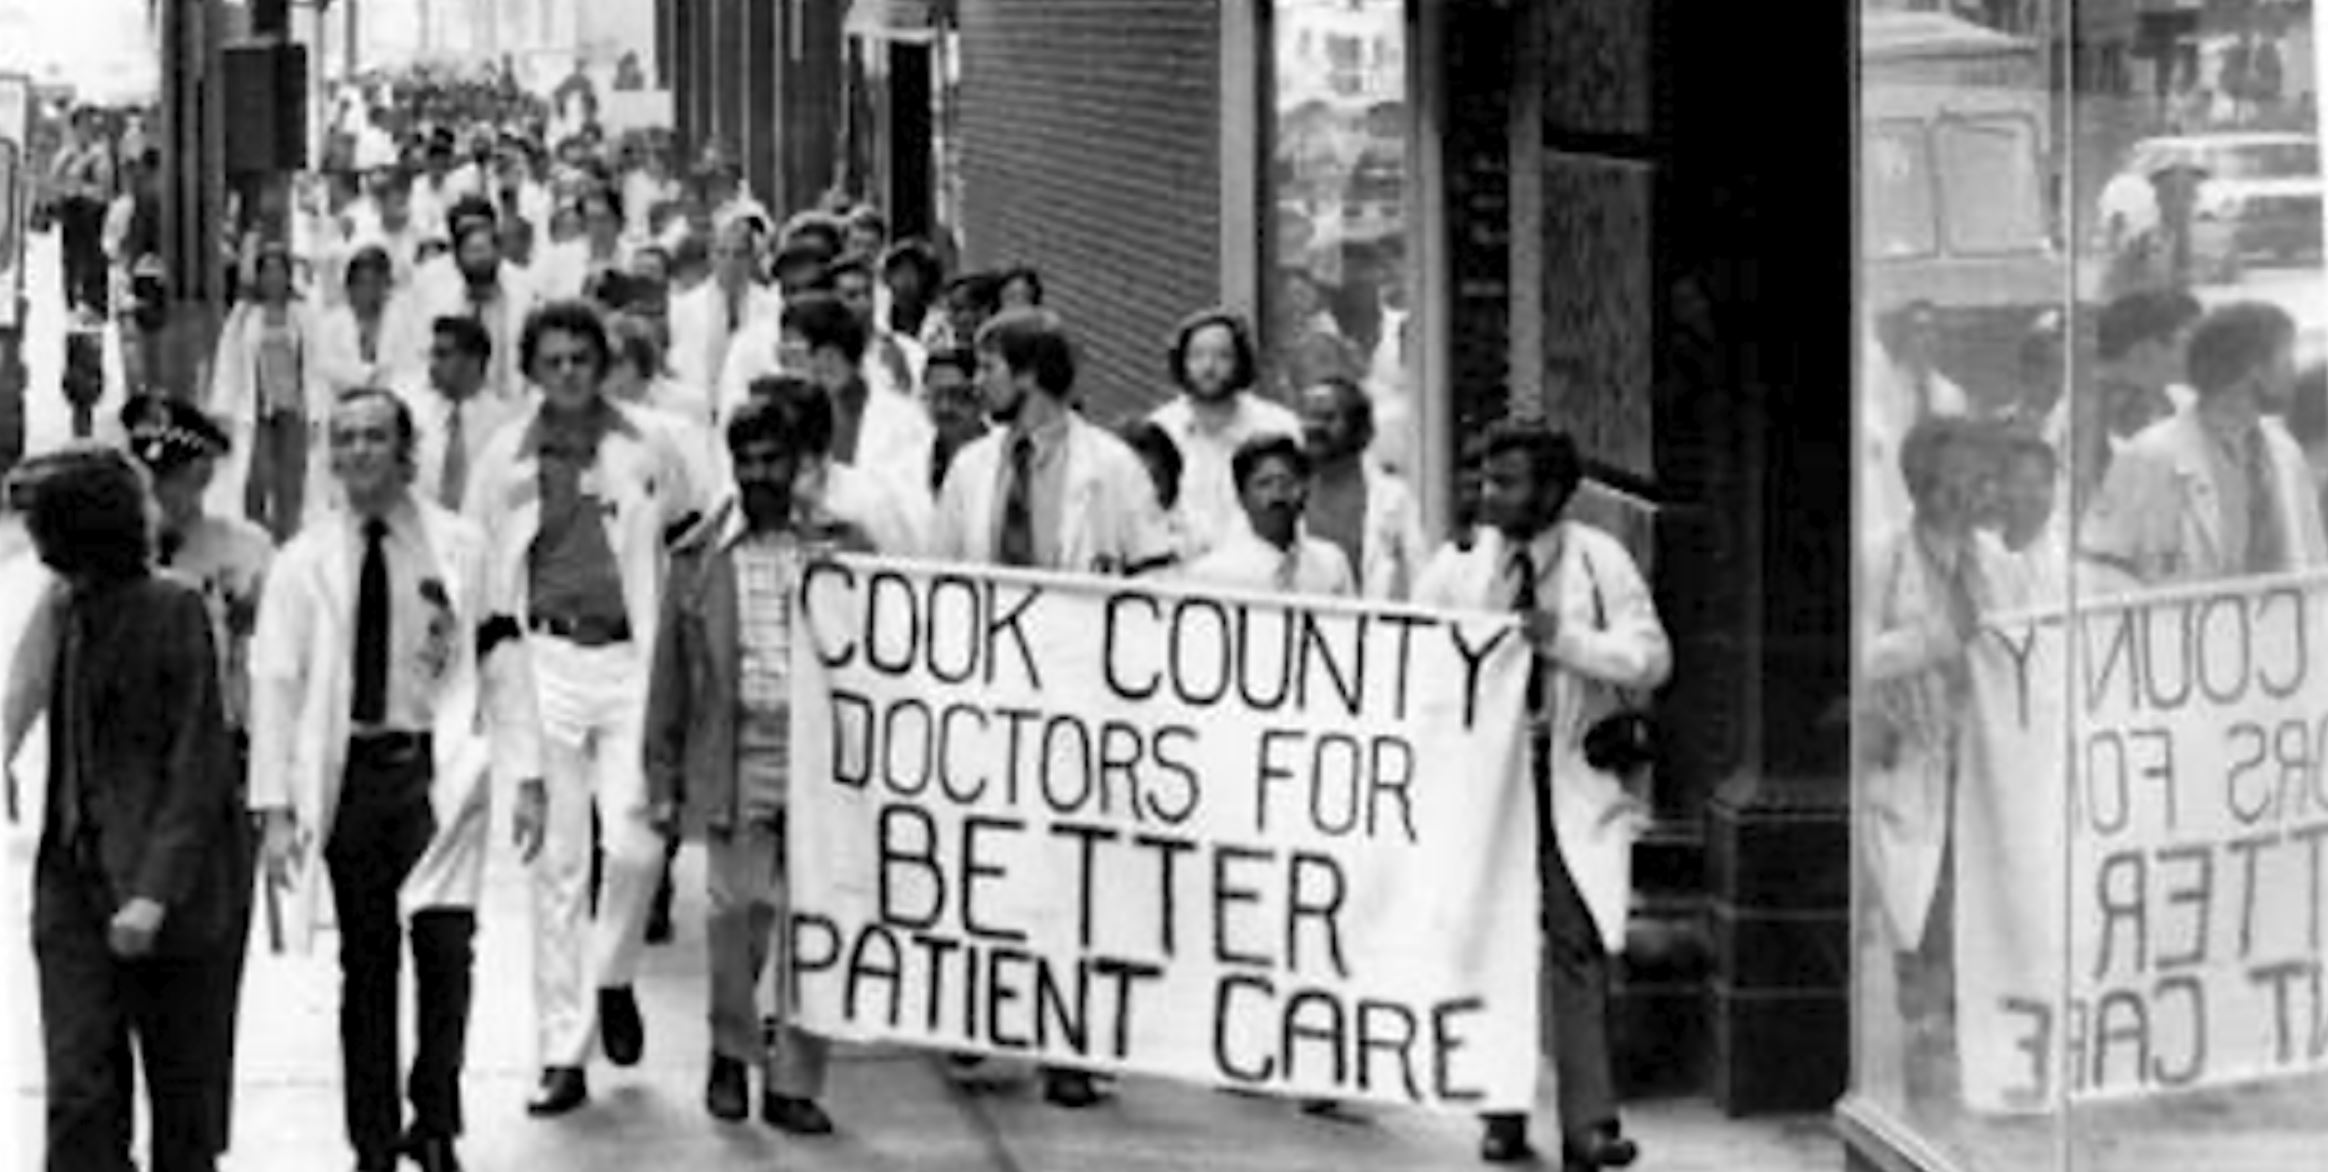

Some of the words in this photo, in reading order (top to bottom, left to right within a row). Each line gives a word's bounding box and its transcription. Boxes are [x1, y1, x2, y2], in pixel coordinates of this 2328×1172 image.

[801, 560, 1042, 690] COOK
[1104, 591, 1511, 732] COUNTY
[830, 688, 1201, 823] DOCTORS
[1257, 729, 1418, 843] FOR
[877, 803, 1349, 978] BETTER
[789, 913, 1164, 1057] PATIENT
[1212, 974, 1487, 1102] CARE
